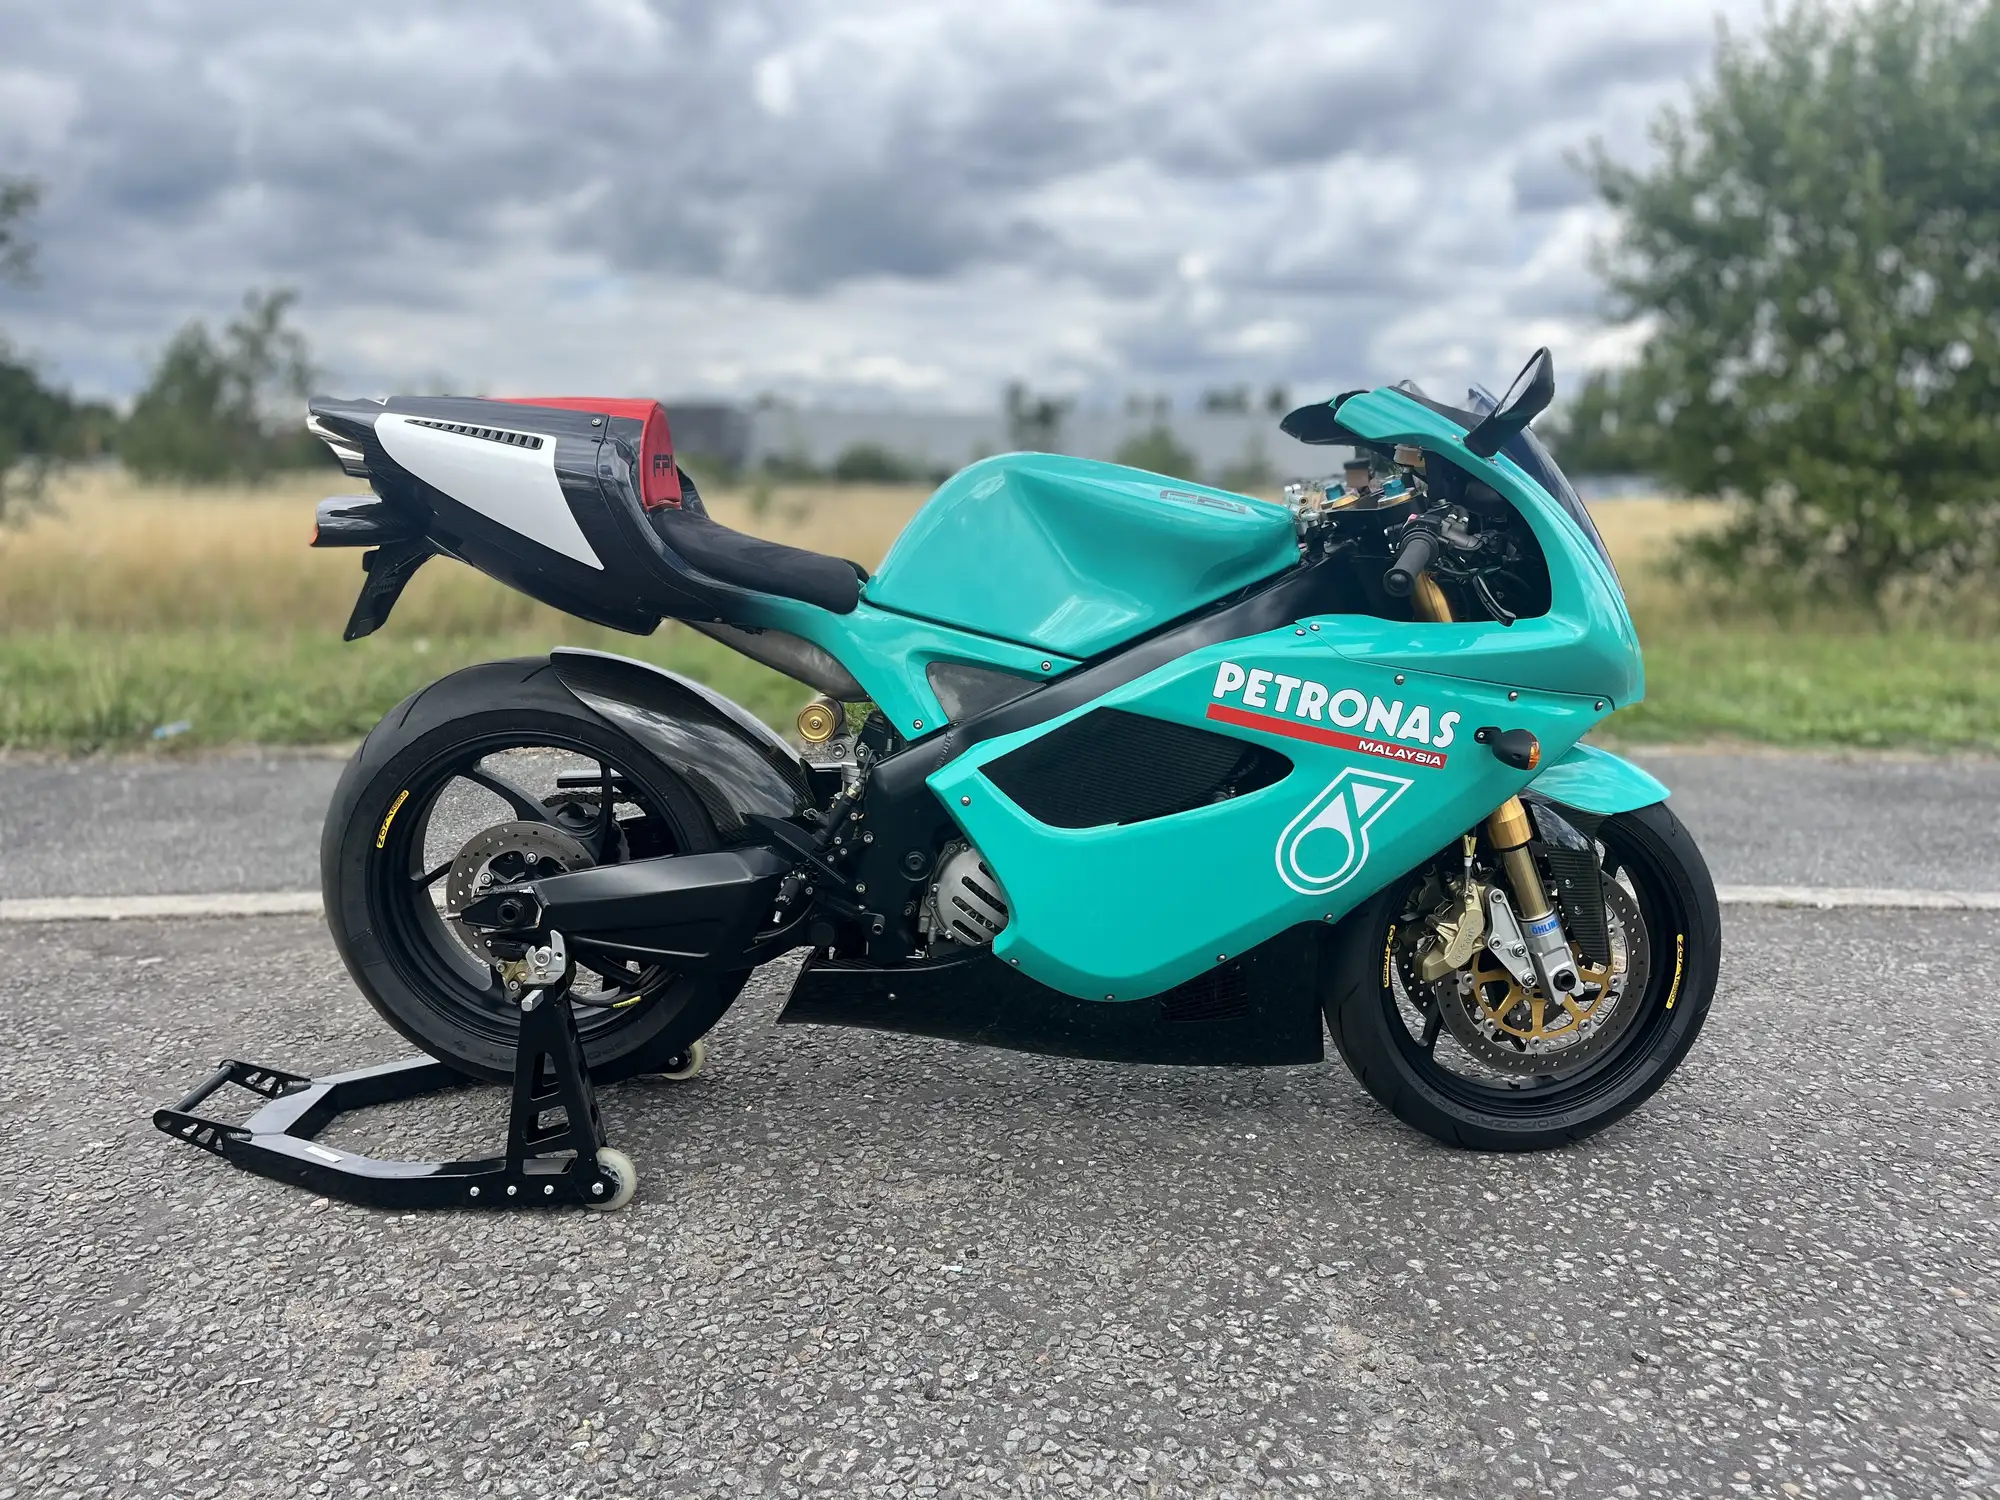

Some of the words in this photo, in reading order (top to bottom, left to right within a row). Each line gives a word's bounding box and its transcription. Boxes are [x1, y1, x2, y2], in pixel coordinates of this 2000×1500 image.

[1212, 661, 1461, 748] PETRONAS
[1358, 740, 1441, 766] MALAYSIA
[1531, 919, 1559, 935] ÖHLIN
